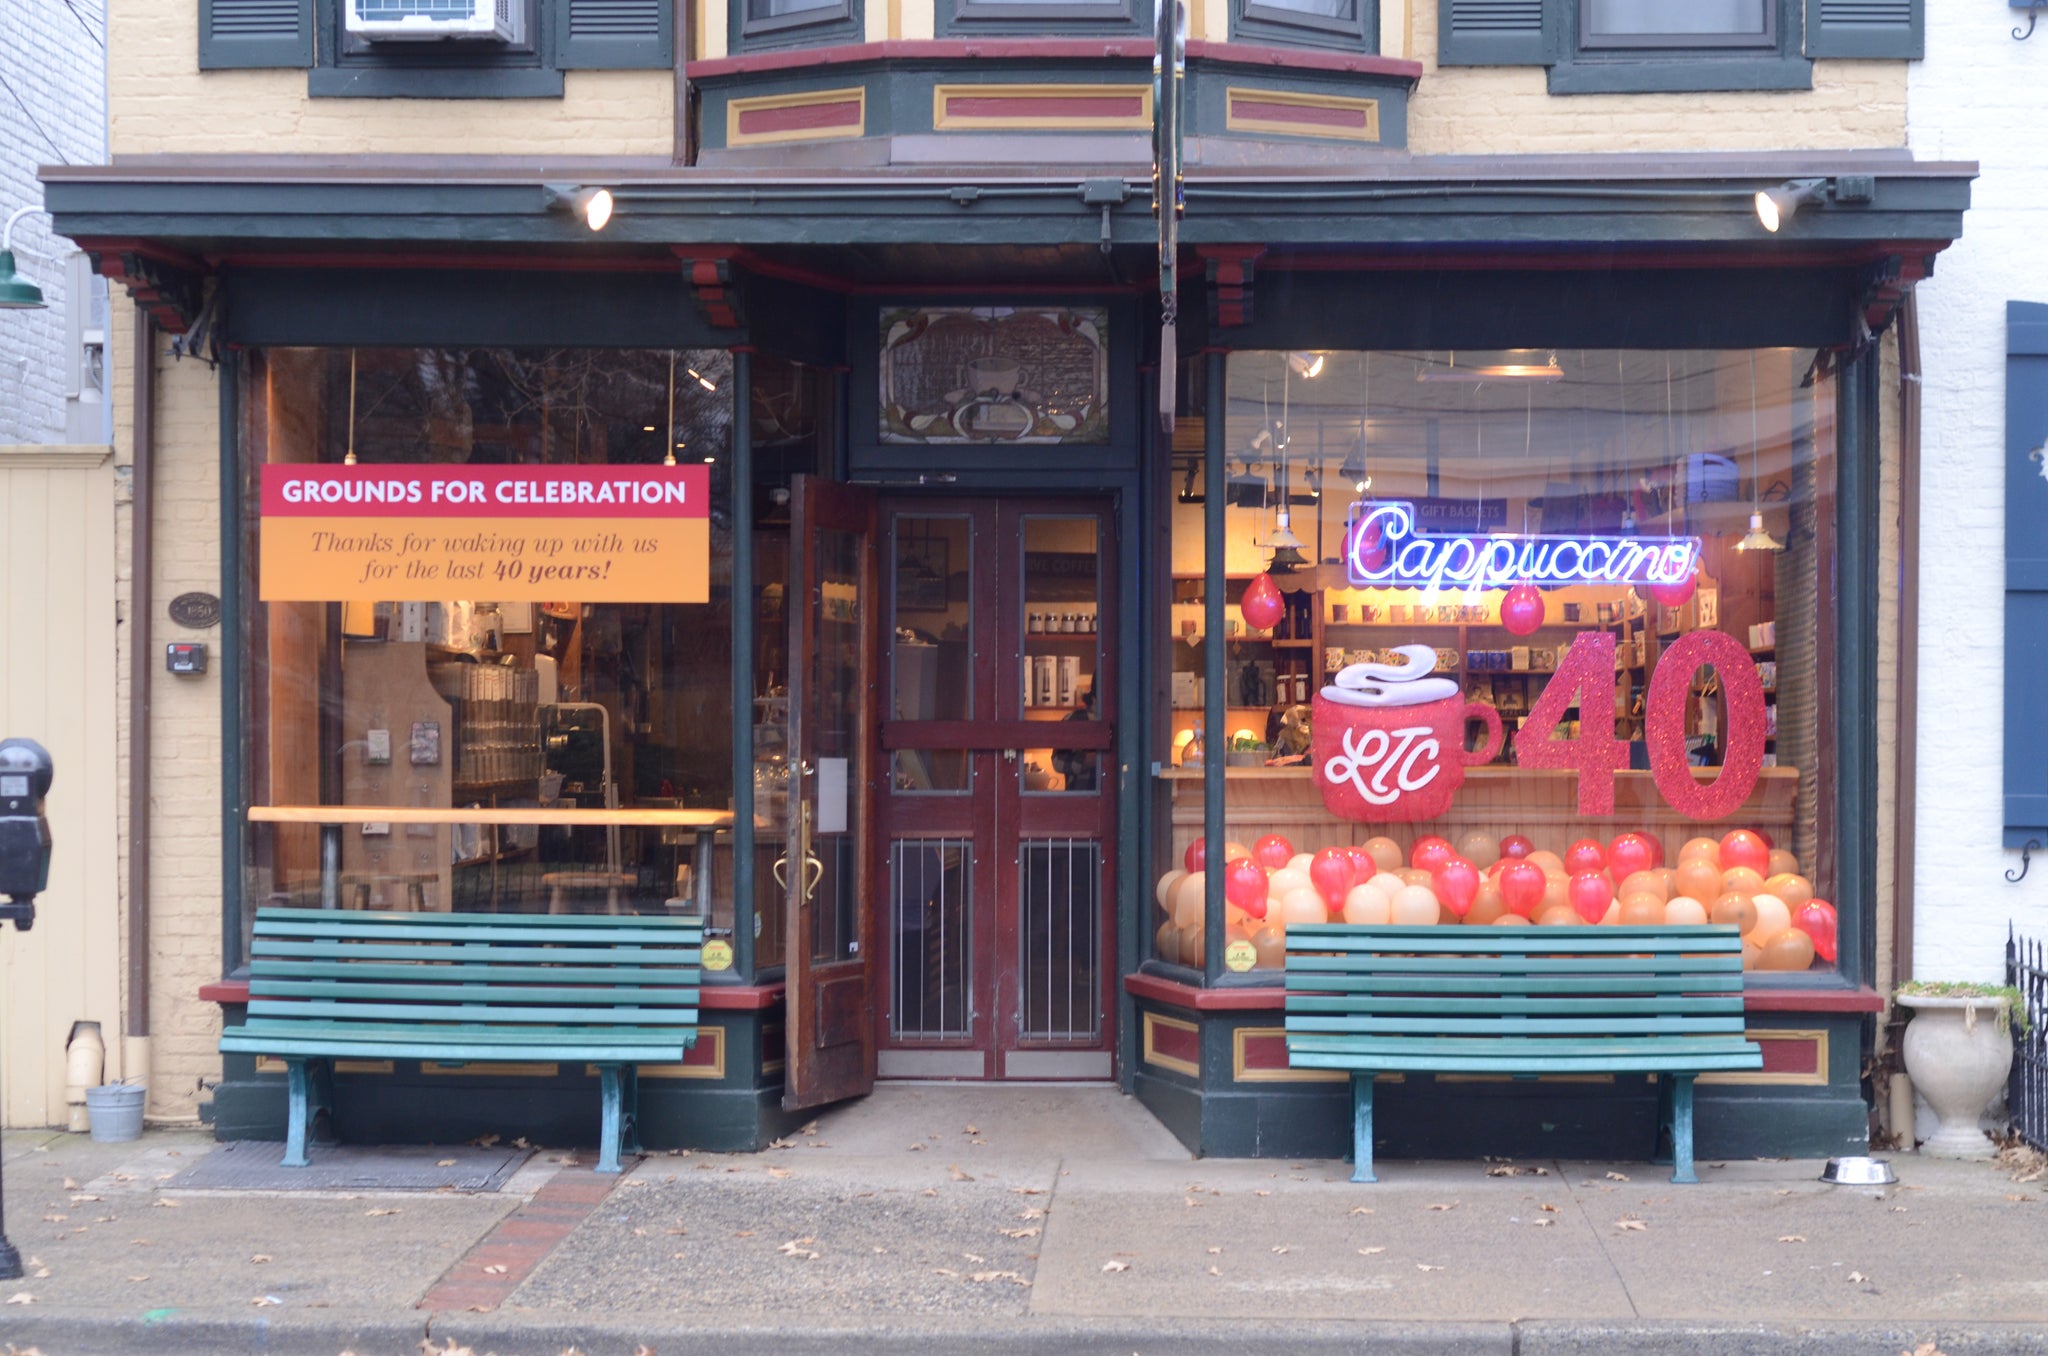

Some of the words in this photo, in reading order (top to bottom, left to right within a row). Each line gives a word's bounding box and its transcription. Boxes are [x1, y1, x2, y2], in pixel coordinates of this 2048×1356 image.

[282, 480, 422, 503] GROUNDS
[431, 480, 487, 503] FOR
[495, 480, 686, 504] CELEBRATION
[1420, 504, 1447, 518] GIFT
[1450, 504, 1501, 519] BASKETS
[312, 531, 394, 553] Thanks
[396, 532, 436, 557] for
[444, 532, 526, 557] waking
[535, 537, 564, 557] up
[572, 532, 624, 553] with
[632, 537, 658, 553] us
[1352, 505, 1694, 602] Cappuccino
[358, 559, 399, 584] for
[406, 560, 439, 580] the
[446, 560, 484, 580] last
[493, 559, 523, 582] 40
[528, 559, 612, 584] years!
[1514, 630, 1767, 821] 40
[1324, 726, 1440, 805] LTC
